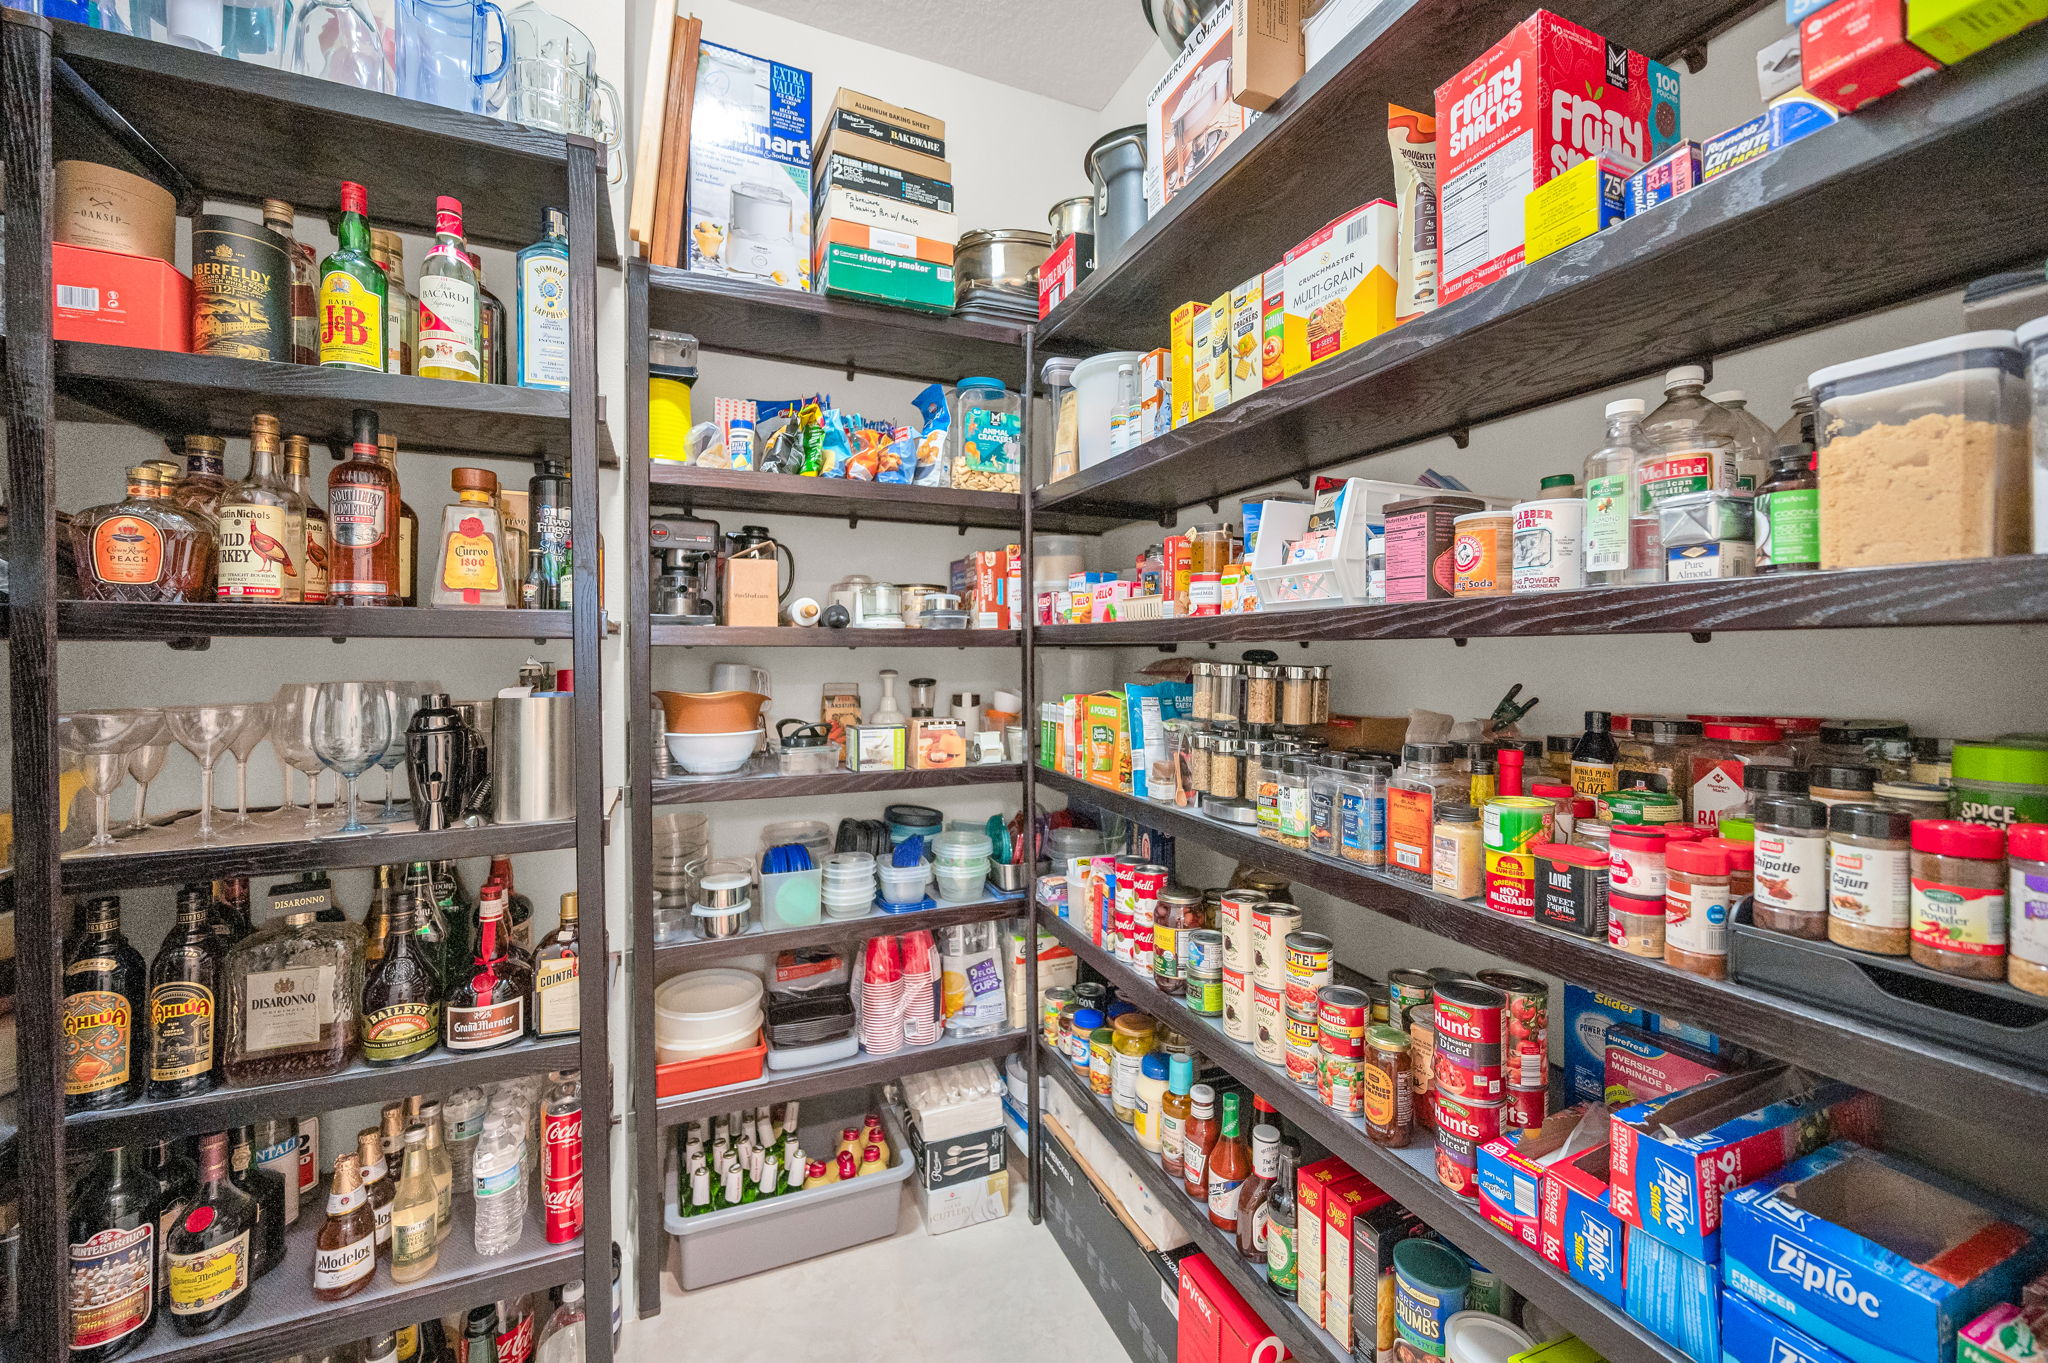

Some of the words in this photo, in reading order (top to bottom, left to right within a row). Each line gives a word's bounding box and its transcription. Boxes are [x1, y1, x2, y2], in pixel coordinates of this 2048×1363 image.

[1551, 23, 1562, 35] NO
[773, 65, 805, 87] EXTRA
[1148, 43, 1196, 107] COMMERCIAL
[1462, 60, 1487, 84] Member's
[1607, 70, 1628, 85] Member's
[772, 77, 806, 100] VALUE!
[1655, 72, 1679, 94] 100
[1656, 88, 1680, 104] POUCHES
[855, 102, 887, 120] ALUMINUM
[888, 110, 911, 125] BAKING
[911, 118, 931, 131] SHEET
[868, 126, 884, 137] Edge
[1706, 123, 1759, 156] Reynolds
[890, 130, 941, 153] BAKEWARE
[1450, 158, 1467, 175] FRUIT
[1467, 143, 1497, 168] FLAVORED
[1497, 126, 1522, 147] SNACKS
[1706, 131, 1771, 168] CUT-RITE
[771, 152, 791, 163] Sorbet
[793, 157, 811, 167] Maker
[1705, 162, 1727, 179] WAX
[1730, 144, 1768, 167] PAPER
[833, 164, 843, 178] 2
[843, 166, 864, 176] PIECE
[1443, 172, 1468, 192] Nutrition
[1470, 160, 1487, 175] Facts
[1479, 179, 1488, 189] 70
[80, 209, 122, 224] OAKSIP
[534, 265, 568, 279] BOMBAY
[859, 253, 896, 268] stovetop
[898, 260, 931, 273] smoker
[1039, 270, 1056, 296] DOUBLE
[1057, 248, 1074, 278] BOILER
[1298, 252, 1357, 287] CRUNCHMASTER
[1444, 279, 1462, 296] GLUTEN
[1462, 274, 1475, 288] FREE
[1478, 259, 1507, 279] NATURALLY
[1507, 254, 1517, 266] FAT
[1293, 262, 1364, 309] MULTI-GRAIN
[422, 288, 470, 305] BACARDI
[1304, 298, 1321, 311] BAKED
[1319, 286, 1348, 304] CRACKERS
[321, 304, 369, 346] J&B
[1174, 308, 1190, 325] Nilla
[1233, 311, 1259, 331] CRACKERS
[977, 432, 1013, 443] CRACKERS
[982, 427, 1008, 437] ANIMAL
[1640, 460, 1705, 484] Molina
[330, 487, 383, 505] SOUTHERN
[220, 509, 236, 519] ustin
[237, 508, 271, 519] Nichols
[333, 501, 378, 517] COMFORT
[545, 515, 570, 528] Two
[1386, 516, 1409, 525] Nutrition
[1410, 513, 1427, 521] Facts
[1516, 519, 1539, 530] GIRL
[109, 555, 149, 563] PEACH
[455, 545, 489, 557] Cuervo
[460, 558, 486, 567] 1800
[1684, 560, 1705, 569] Pure
[1469, 579, 1493, 588] Soda
[1523, 576, 1561, 587] POWDER
[1676, 569, 1712, 580] Almond
[1074, 596, 1090, 606] JELL-O
[1095, 587, 1113, 600] JELL-O
[1576, 781, 1607, 794] GLAZE
[1961, 801, 2017, 823] SPICE
[1832, 873, 1869, 890] Cajun
[1490, 890, 1533, 906] MUSTARD
[1499, 887, 1520, 898] HOT
[1546, 893, 1576, 908] SWEET
[274, 895, 325, 910] DISARONNO
[1547, 902, 1575, 916] Paprika
[1927, 902, 1958, 916] Chili
[1920, 909, 1969, 927] Powder
[973, 978, 999, 994] CUPS
[251, 993, 316, 1010] DISARONNO
[1254, 991, 1279, 1009] LINDSAY
[1594, 992, 1637, 1014] Slider
[370, 1003, 430, 1025] BAILEYS
[1440, 1038, 1471, 1057] Diced
[1448, 1036, 1472, 1049] Roasted
[1608, 1033, 1650, 1054] surefresh
[1611, 1052, 1667, 1080] OVERSIZED
[1611, 1061, 1663, 1090] MARINADE
[1439, 1133, 1468, 1154] Diced
[1617, 1125, 1630, 1176] STORAGE
[1298, 1183, 1318, 1201] Stove
[1304, 1193, 1317, 1207] Top
[1549, 1176, 1558, 1226] STORAGE
[1617, 1185, 1633, 1217] 166
[1660, 1166, 1687, 1236] Ziploc
[1701, 1157, 1715, 1229] STORAGE
[1326, 1202, 1348, 1220] Stove
[1649, 1181, 1662, 1225] Slider
[1333, 1215, 1346, 1228] Top
[1546, 1233, 1561, 1263] 166
[1573, 1231, 1585, 1271] Slider
[1585, 1219, 1609, 1282] Ziploc
[1778, 1239, 1881, 1318] Ziploc
[1182, 1275, 1213, 1324] pyrex
[1731, 1269, 1797, 1316] FREEZER
[1731, 1279, 1769, 1306] QUART
[1398, 1290, 1432, 1319] BREAD
[1395, 1296, 1440, 1339] CRUMBS
